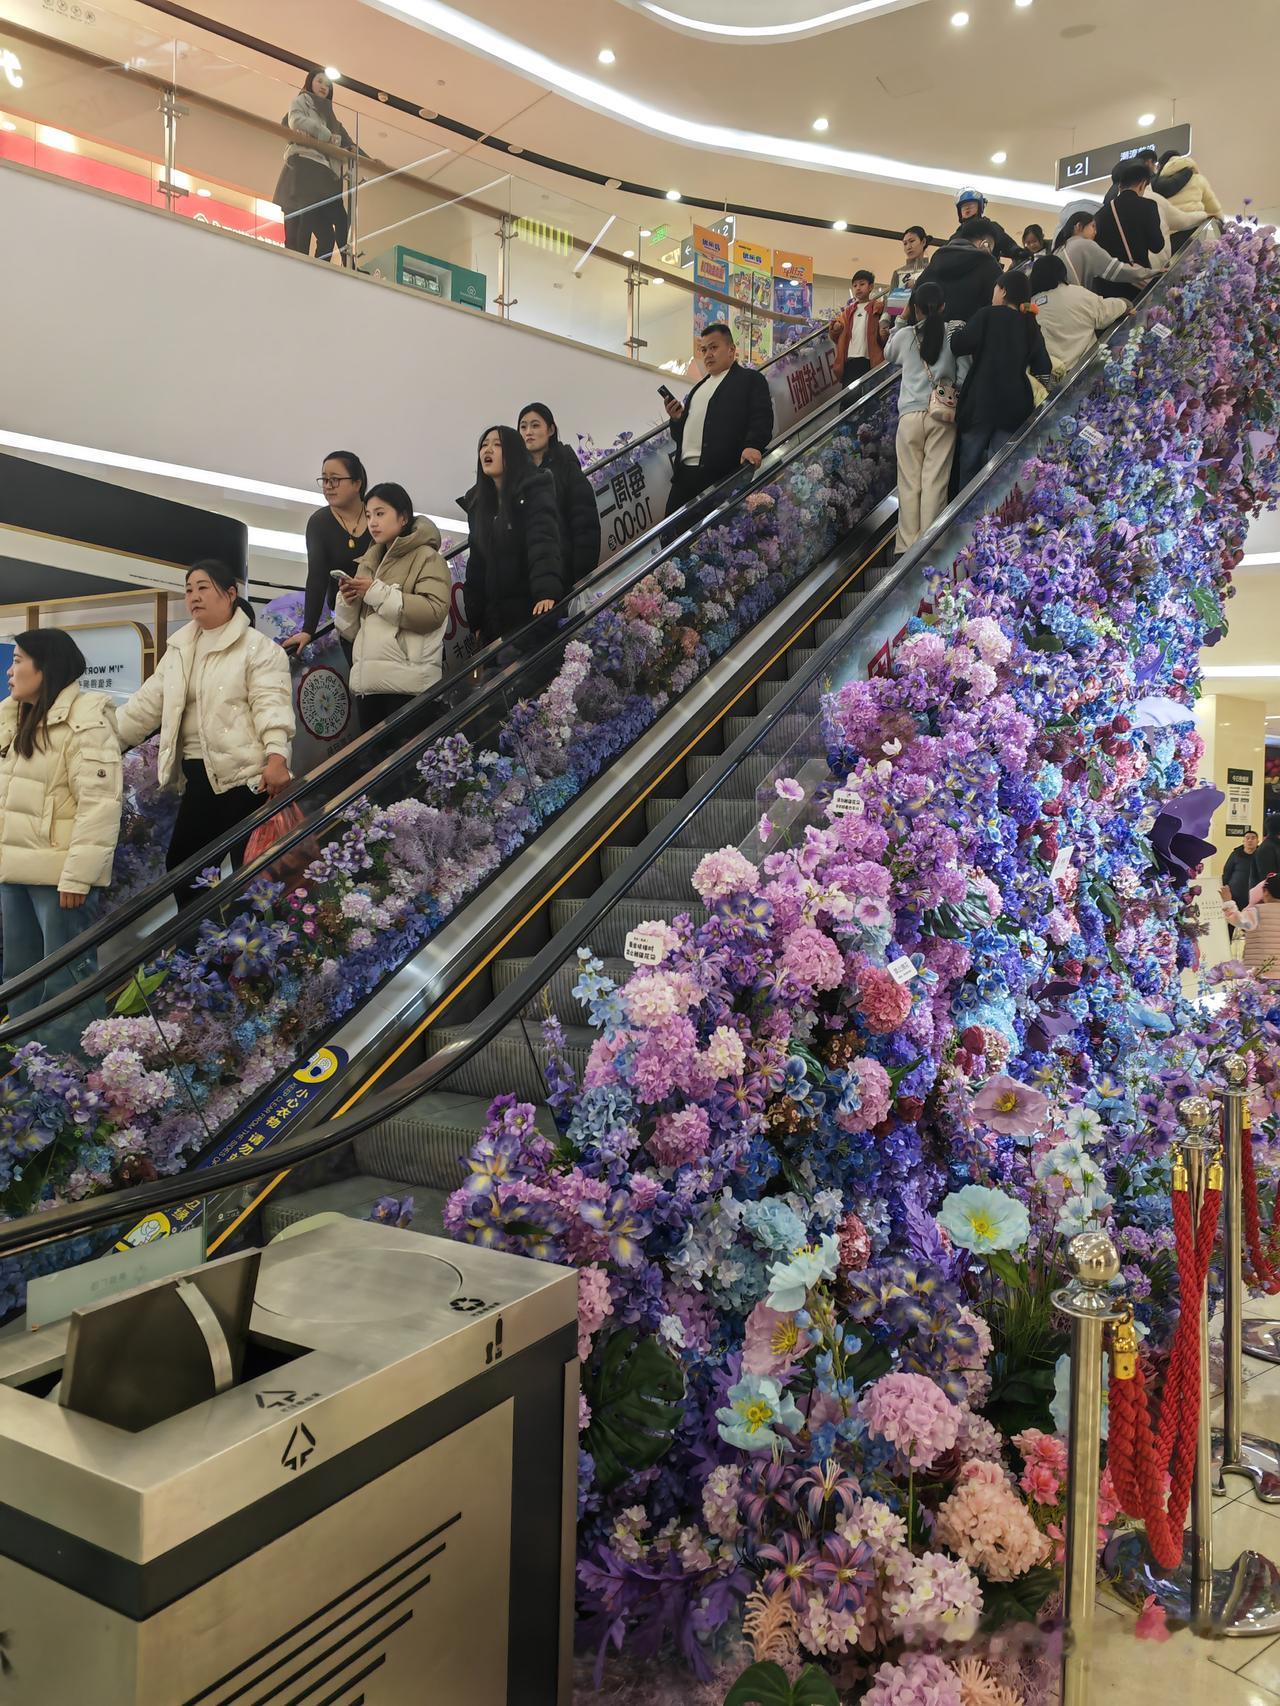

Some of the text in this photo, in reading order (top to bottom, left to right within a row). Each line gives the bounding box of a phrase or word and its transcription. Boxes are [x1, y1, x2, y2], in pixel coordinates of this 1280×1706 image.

[1067, 163, 1083, 177] L2
[283, 1082, 298, 1096] KEEP
[265, 1095, 284, 1115] CLEAR
[266, 1088, 309, 1129] 小心衣物
[249, 1113, 267, 1131] FROM
[237, 1126, 250, 1142] THE
[218, 1140, 238, 1157] SIDES
